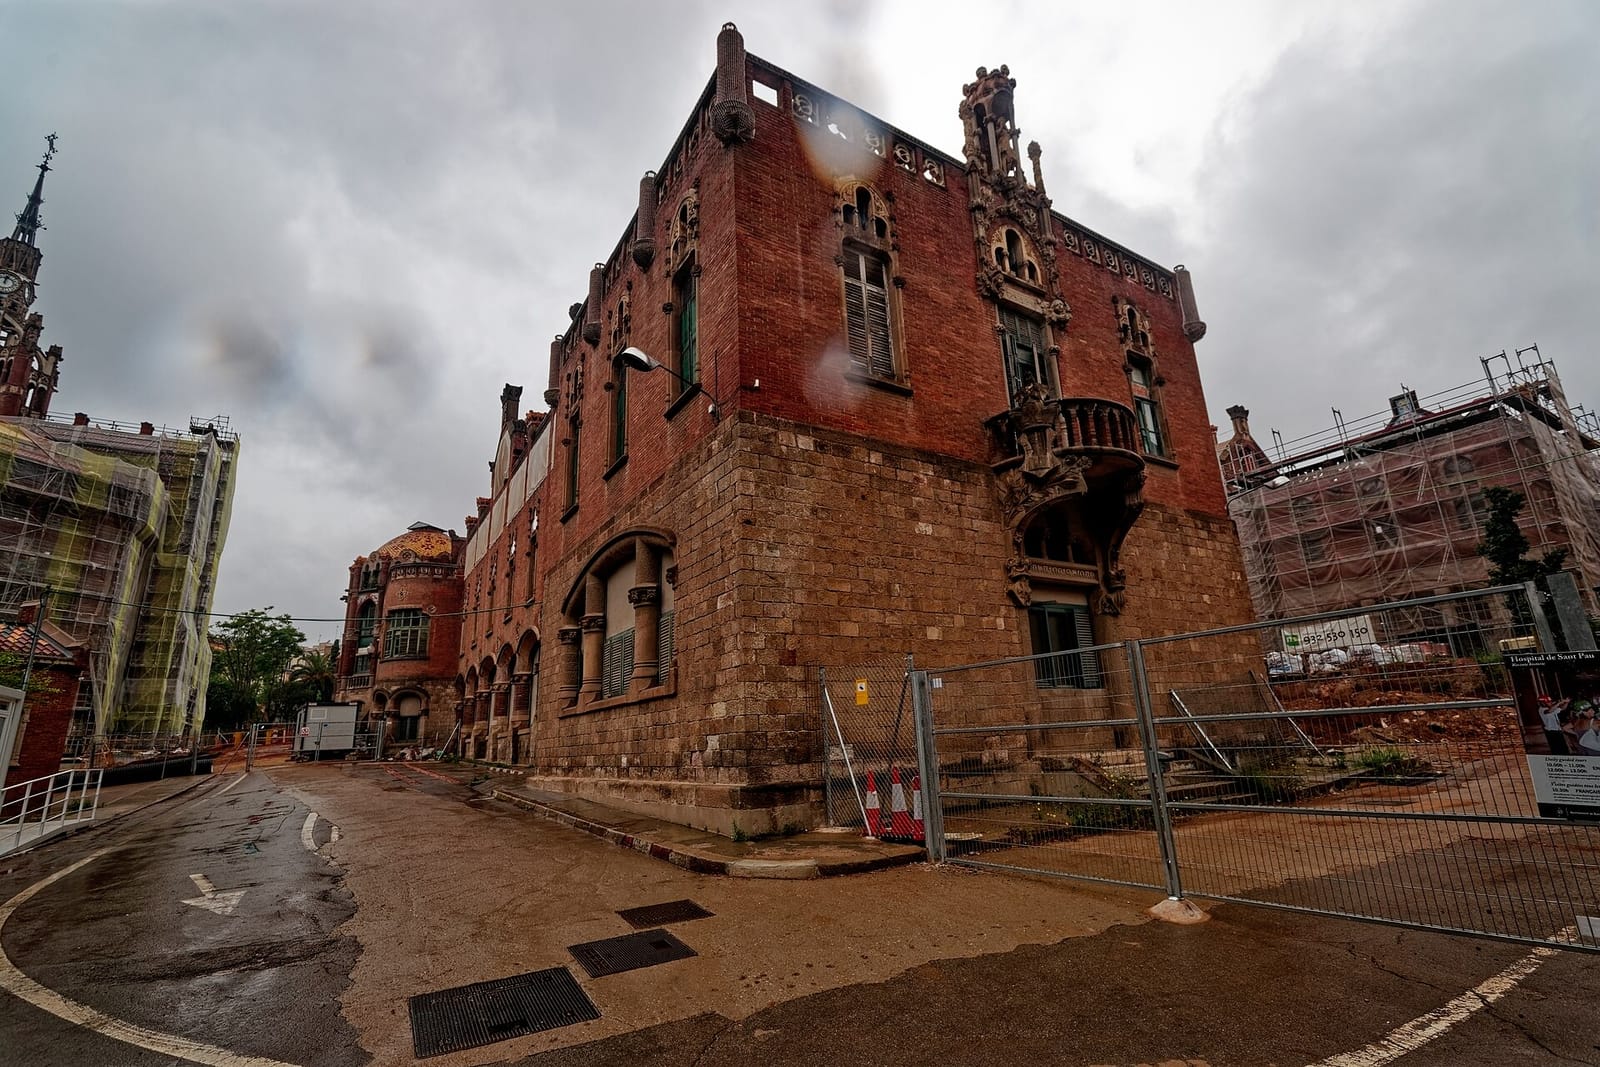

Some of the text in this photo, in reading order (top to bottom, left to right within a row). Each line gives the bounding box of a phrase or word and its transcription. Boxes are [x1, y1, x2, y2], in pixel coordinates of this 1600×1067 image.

[1303, 635, 1323, 645] 932
[1327, 631, 1345, 642] 530
[1350, 627, 1368, 638] 150
[1510, 654, 1545, 663] Hospital
